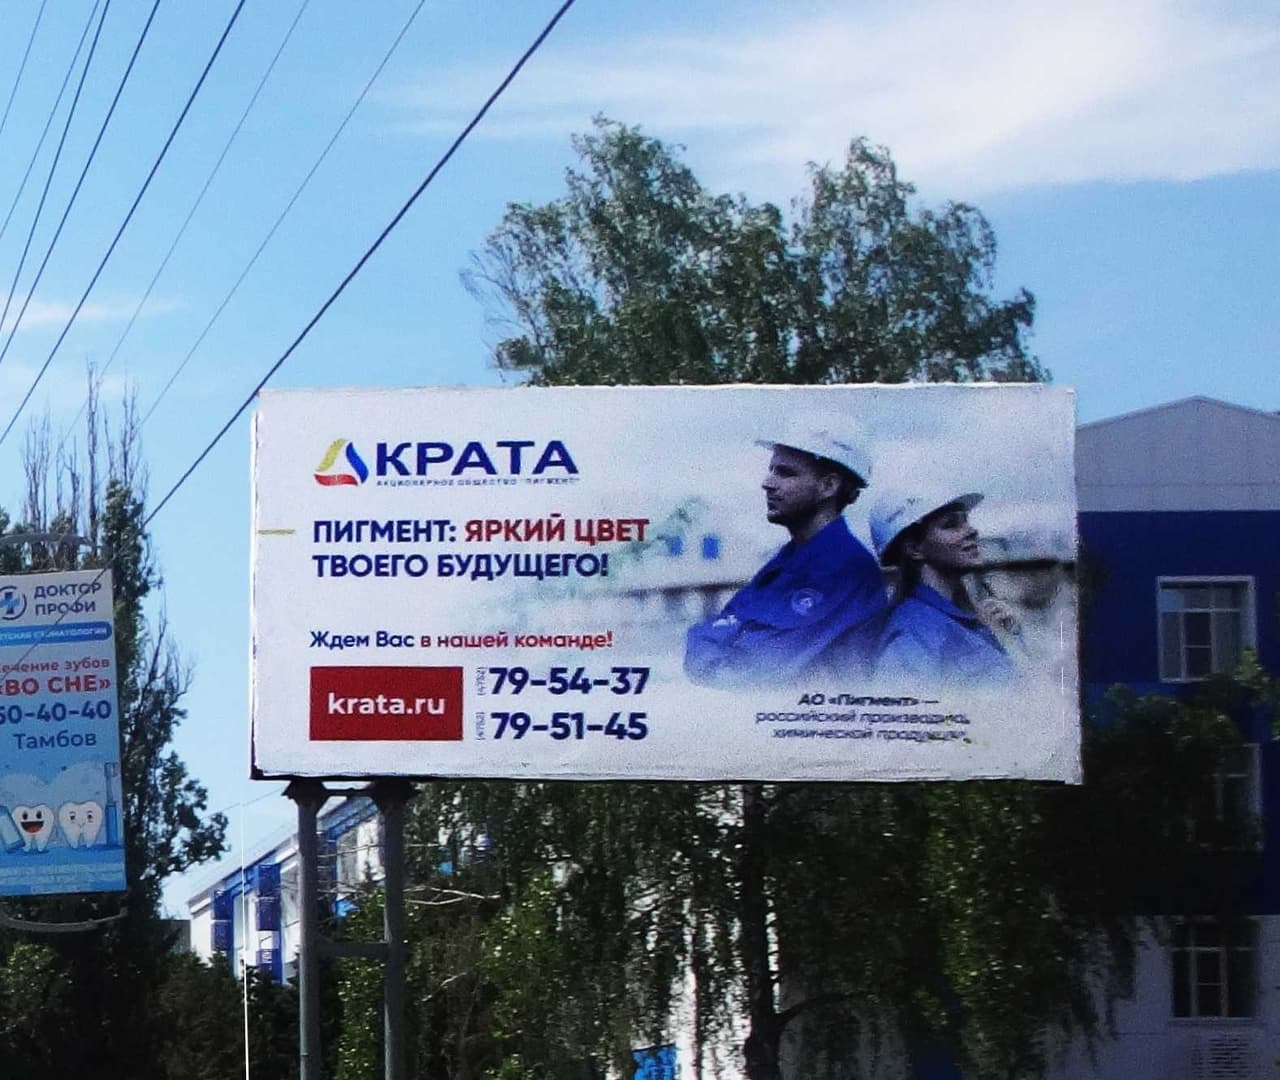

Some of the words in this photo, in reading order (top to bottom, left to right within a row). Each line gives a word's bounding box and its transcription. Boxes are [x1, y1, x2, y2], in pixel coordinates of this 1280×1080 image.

[376, 440, 579, 476] КРАТА
[313, 520, 456, 543] ПИГМЕНТ:
[464, 513, 566, 543] ЯРКИЙ
[574, 518, 650, 546] ЦВЕТ
[312, 554, 428, 578] ТВОЕГО
[437, 553, 609, 581] БУДУЩЕГО!
[34, 582, 102, 599] ДОКТОР
[35, 601, 96, 616] ПРОФИ
[310, 631, 370, 650] Ждем
[376, 631, 415, 647] Вас
[421, 633, 431, 647] в
[438, 630, 509, 648] нашей
[515, 629, 613, 650] команде!
[65, 657, 111, 672] зубов
[48, 675, 111, 693] СНЕ»
[489, 666, 650, 695] 79-54-37
[327, 692, 445, 716] krata.ru
[798, 694, 825, 706] АО
[828, 693, 918, 706] «Пигмент»
[490, 712, 649, 741] 79-51-45
[756, 710, 856, 724] российский
[13, 730, 97, 749] Тамбов
